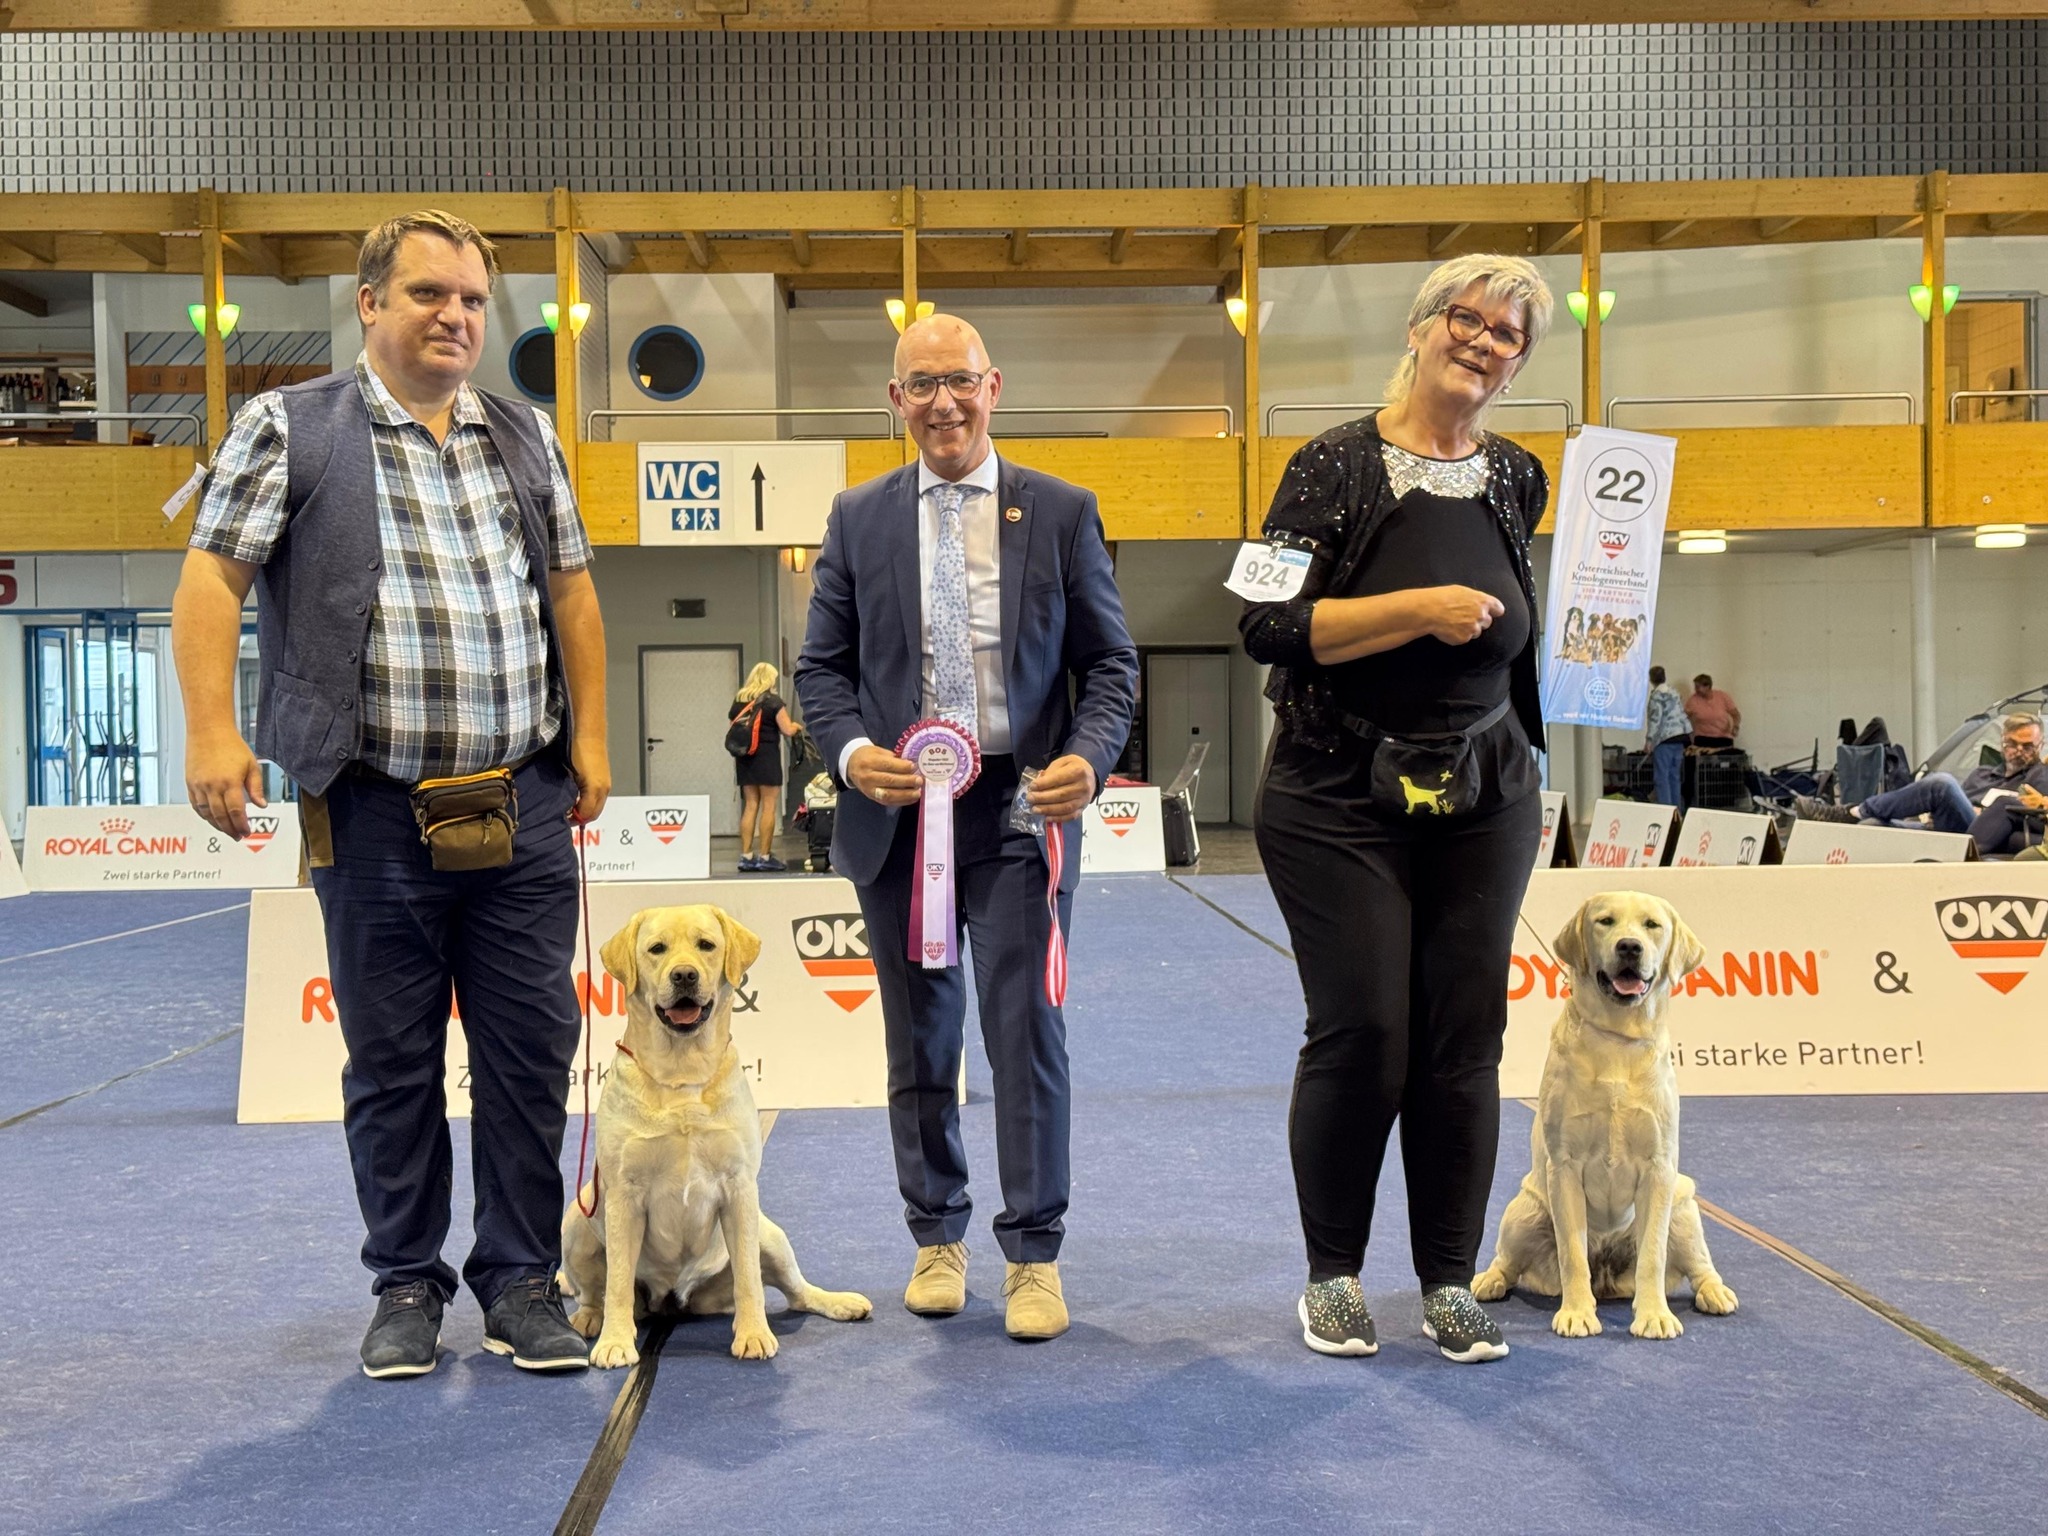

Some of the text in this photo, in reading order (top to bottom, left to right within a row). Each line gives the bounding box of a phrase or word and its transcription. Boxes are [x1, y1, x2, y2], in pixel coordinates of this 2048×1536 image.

[647, 462, 718, 499] WC
[1595, 466, 1646, 504] 22
[1243, 560, 1290, 589] 924
[45, 817, 278, 856] ROYAL CANIN & KV
[619, 828, 634, 846] &
[103, 868, 222, 881] Zwei starke Partner!
[589, 861, 635, 872] Partner!
[1669, 950, 1820, 998] ANIN
[1874, 950, 1913, 994] &
[1694, 1041, 1788, 1067] starke
[1799, 1039, 1925, 1067] Partner!
